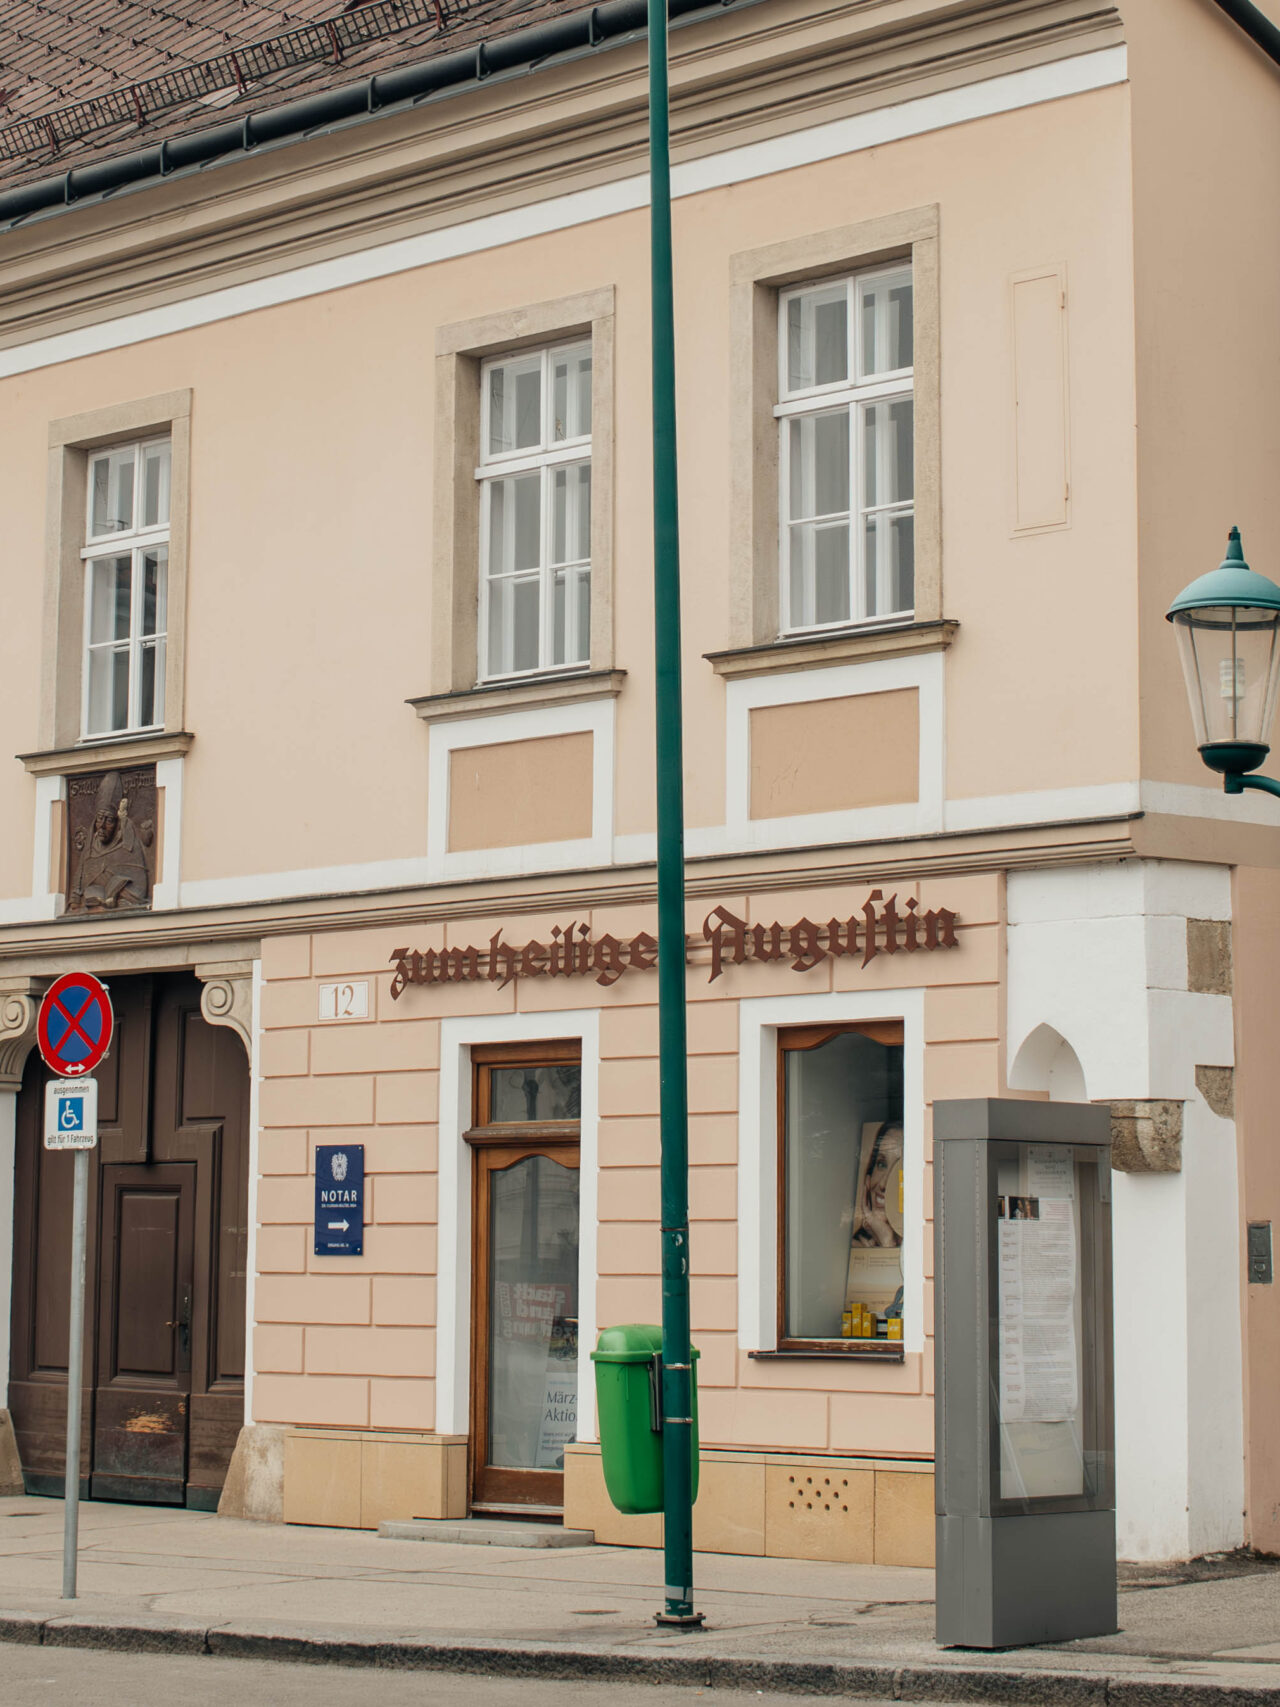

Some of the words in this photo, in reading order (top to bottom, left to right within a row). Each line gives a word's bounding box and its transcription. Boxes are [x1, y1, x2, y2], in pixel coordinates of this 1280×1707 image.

[389, 944, 480, 1001] zum
[490, 920, 691, 992] heilige
[331, 984, 355, 1018] 12
[53, 1085, 90, 1096] ausgenommen
[70, 1133, 94, 1145] Fahrzeug
[321, 1190, 357, 1202] NOTAR
[544, 1407, 577, 1423] Aktio
